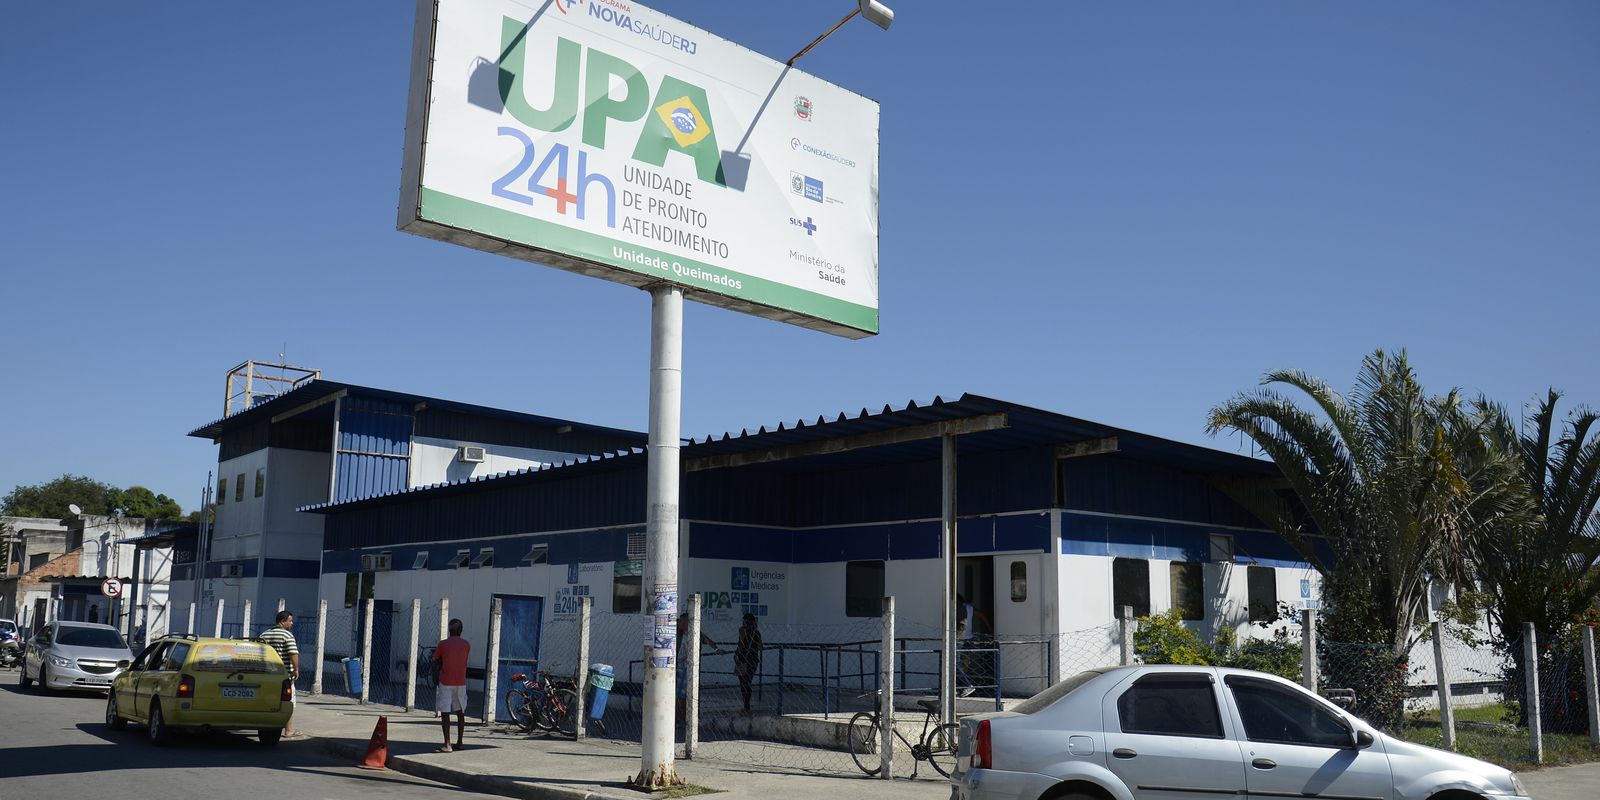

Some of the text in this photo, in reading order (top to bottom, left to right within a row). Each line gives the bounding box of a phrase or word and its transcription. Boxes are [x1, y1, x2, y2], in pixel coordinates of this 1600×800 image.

[498, 15, 727, 189] UPA
[491, 126, 616, 228] 24h
[623, 164, 693, 200] UNIDADE
[623, 190, 707, 229] DE PRONTO
[789, 217, 803, 227] SUS
[622, 216, 729, 259] ATENDIMENTO
[613, 246, 742, 289] Unidade Queimados
[789, 249, 846, 274] Ministério da
[818, 270, 846, 286] Saúde
[751, 570, 785, 580] Urgências
[751, 581, 780, 590] Médicas
